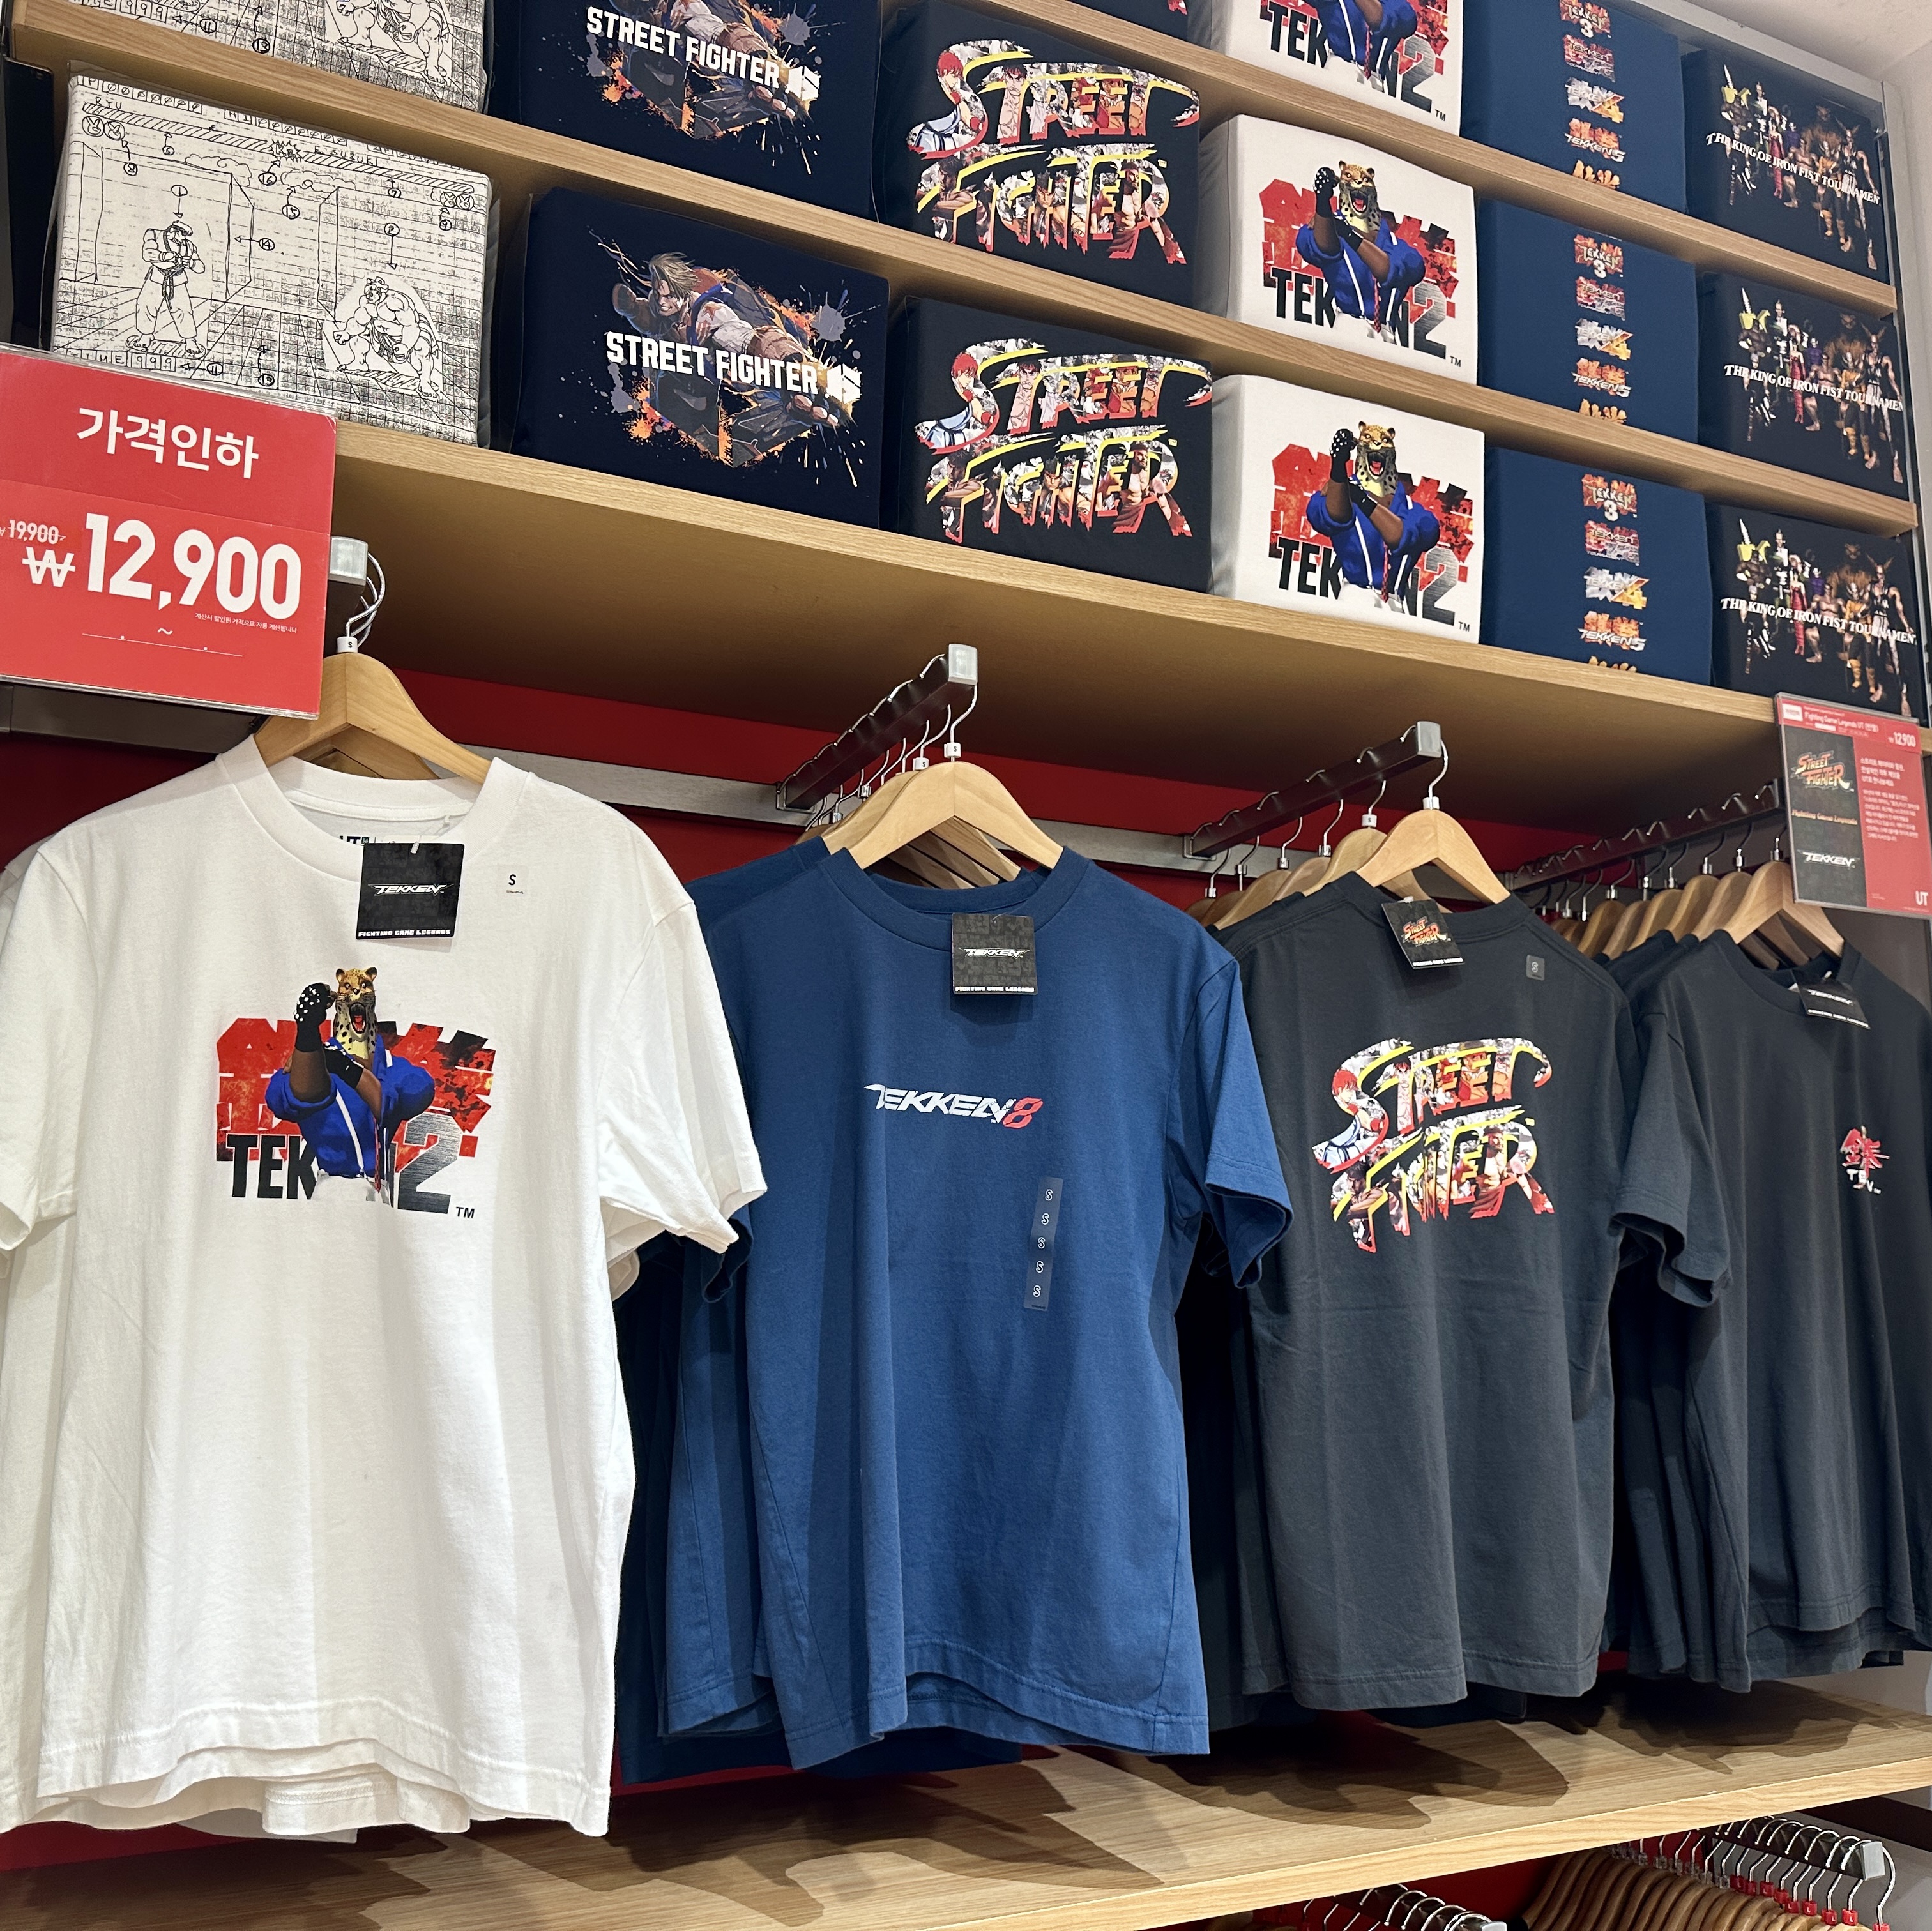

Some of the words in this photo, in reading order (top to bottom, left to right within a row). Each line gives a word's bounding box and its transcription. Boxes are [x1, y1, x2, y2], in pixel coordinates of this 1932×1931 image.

[1580, 18, 1594, 38] 3
[587, 6, 680, 58] STREET
[686, 35, 780, 89] FIGHTER
[906, 38, 1201, 160] STREET
[1732, 137, 1757, 158] KING
[1799, 167, 1821, 183] FIST
[917, 142, 1188, 265] FIGHTER
[1594, 259, 1607, 278] 3
[606, 331, 711, 376] STREET
[716, 349, 818, 395] FIGHTER
[1750, 370, 1776, 384] KING
[1793, 379, 1819, 394] IRON
[1820, 385, 1843, 399] FIST
[913, 338, 1213, 455] STREET
[77, 407, 259, 479] 가격인하
[925, 424, 1193, 543] FIGHTER
[1604, 500, 1619, 521] 3
[1748, 602, 1776, 617] KING
[1794, 611, 1821, 625] IRON
[1823, 616, 1848, 630] FIST
[1459, 621, 1470, 633] TM
[1795, 753, 1831, 775] STREET
[1801, 764, 1851, 789] FIGHTER
[1802, 851, 1856, 867] TEKKEN
[373, 884, 447, 895] TEKKEN
[508, 874, 517, 886] S
[1915, 890, 1929, 906] UT
[964, 948, 1024, 958] TEKKEN
[1312, 1036, 1553, 1174] STREET
[1045, 1188, 1053, 1201] S
[455, 1206, 475, 1219] TM
[1041, 1213, 1050, 1225] S
[1037, 1236, 1046, 1249] S
[1035, 1261, 1044, 1273] S
[1033, 1285, 1042, 1298] S
